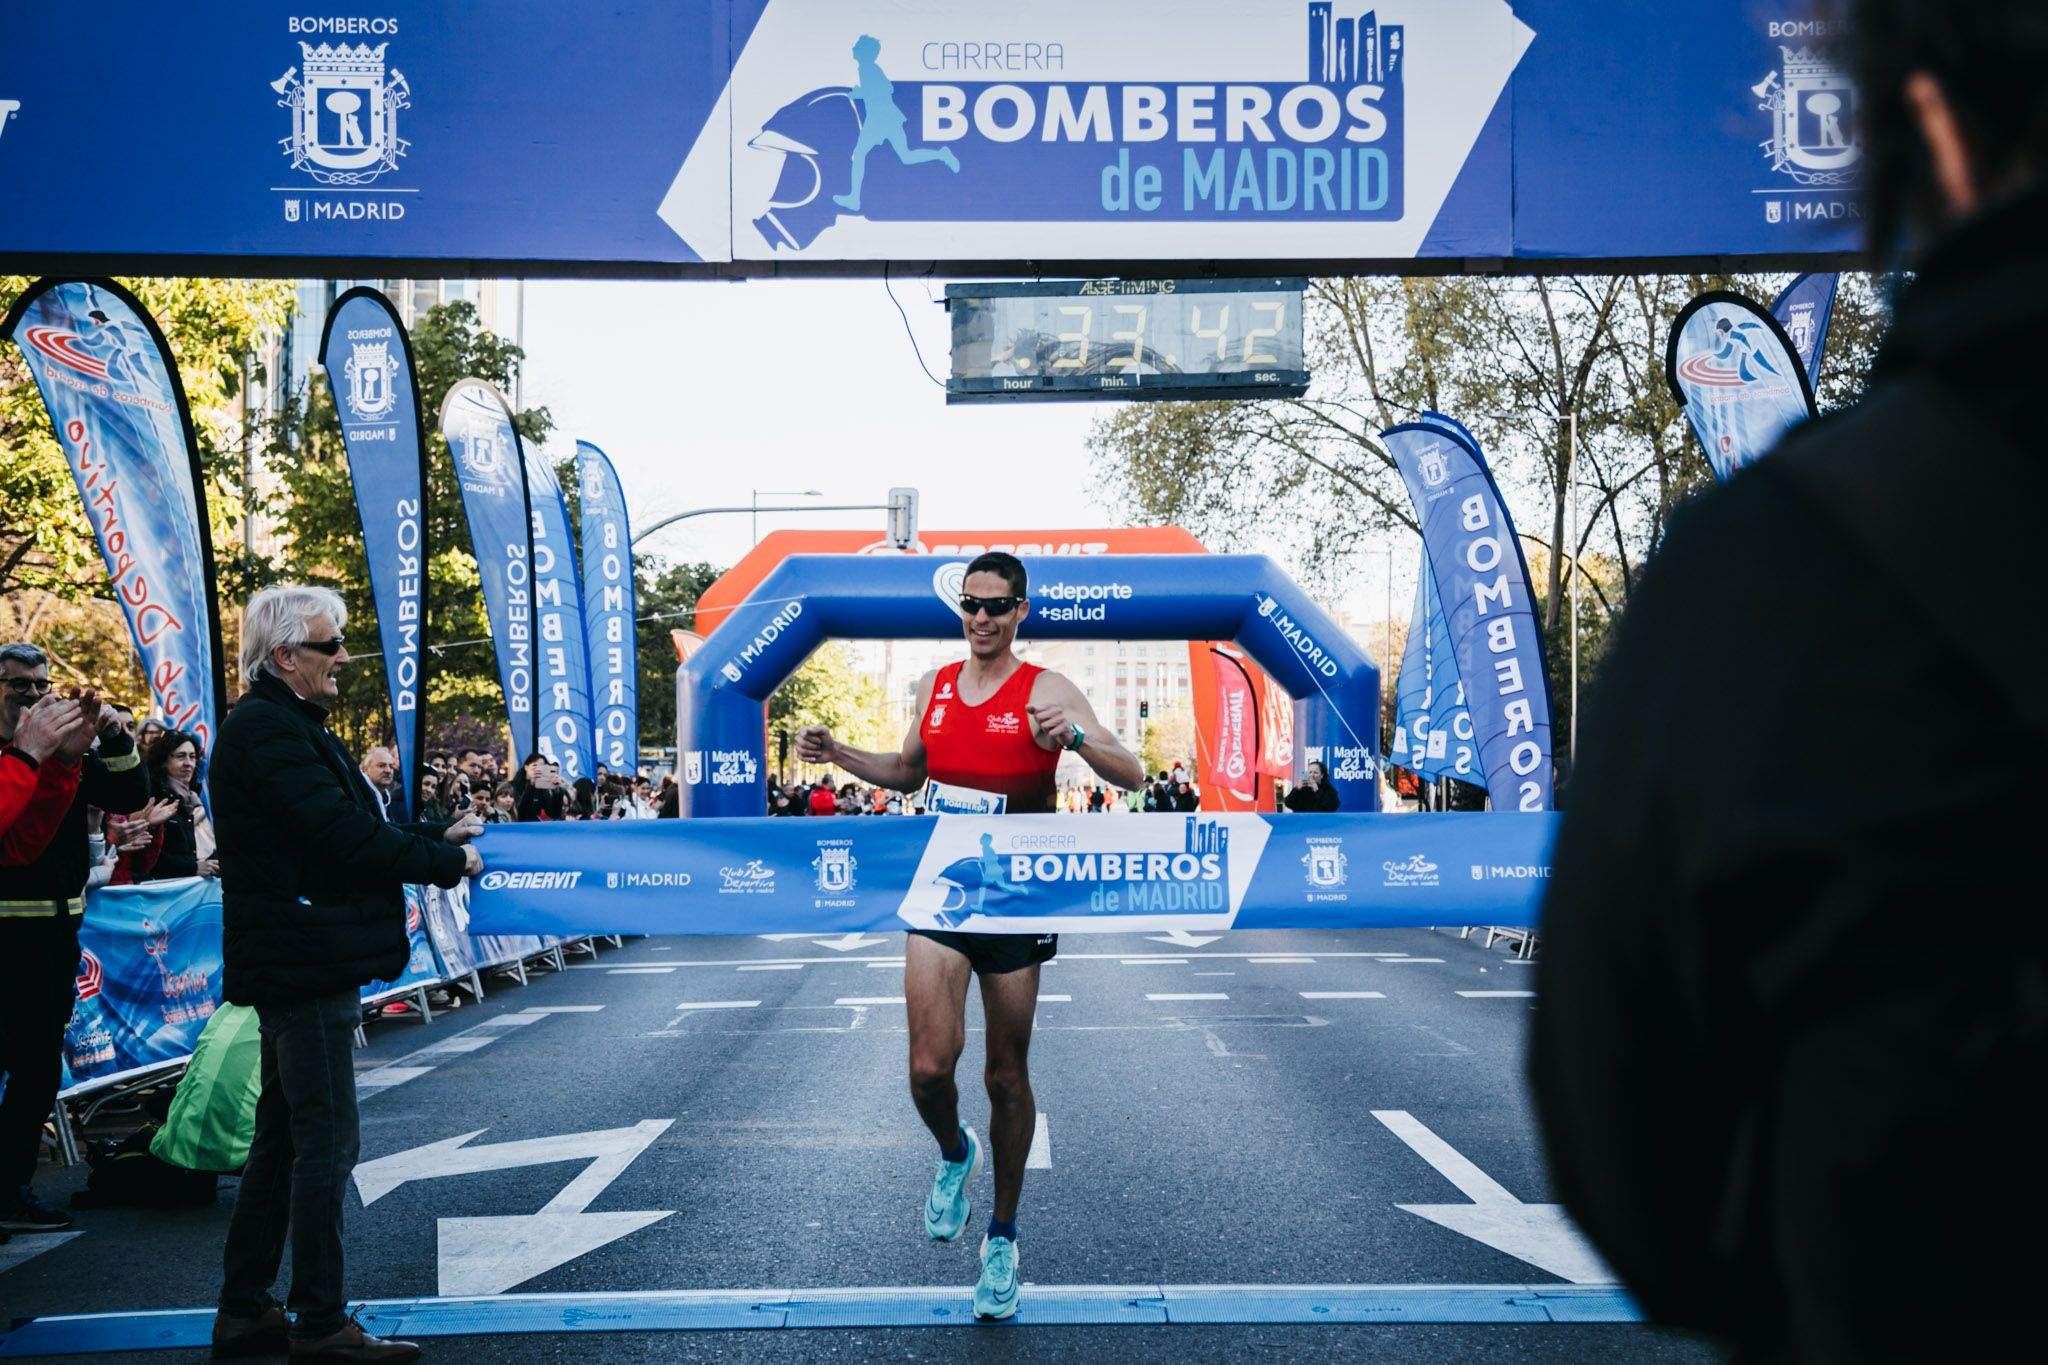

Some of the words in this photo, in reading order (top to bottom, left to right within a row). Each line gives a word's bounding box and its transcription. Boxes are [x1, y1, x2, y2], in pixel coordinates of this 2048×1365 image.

[288, 16, 398, 35] BOMBEROS
[921, 41, 1065, 71] CARRERA
[922, 84, 1388, 144] BOMBEROS
[1100, 147, 1163, 213] de
[1183, 148, 1390, 212] MADRID
[314, 201, 405, 221] MADRID
[1078, 279, 1176, 297] ALGE-TIMING
[1003, 378, 1033, 390] hour
[1100, 376, 1128, 387] min.
[1254, 371, 1280, 382] sec.
[1038, 582, 1133, 603] +deporte
[1038, 604, 1106, 621] +salud
[741, 601, 802, 664] MADRID
[1276, 615, 1338, 677] MADRID
[712, 750, 750, 763] Madrid
[1334, 745, 1369, 759] Madrid
[712, 772, 756, 785] Deporte
[816, 839, 854, 847] BOMBEROS
[1011, 835, 1077, 850] CARRERA
[719, 866, 744, 877] Club
[1010, 853, 1223, 882] BOMBEROS
[507, 871, 583, 889] ENERVIT
[627, 872, 691, 887] MADRID
[824, 900, 856, 908] MADRID
[1090, 883, 1120, 913] de
[1128, 881, 1223, 912] MADRID
[1316, 894, 1348, 902] MADRID
